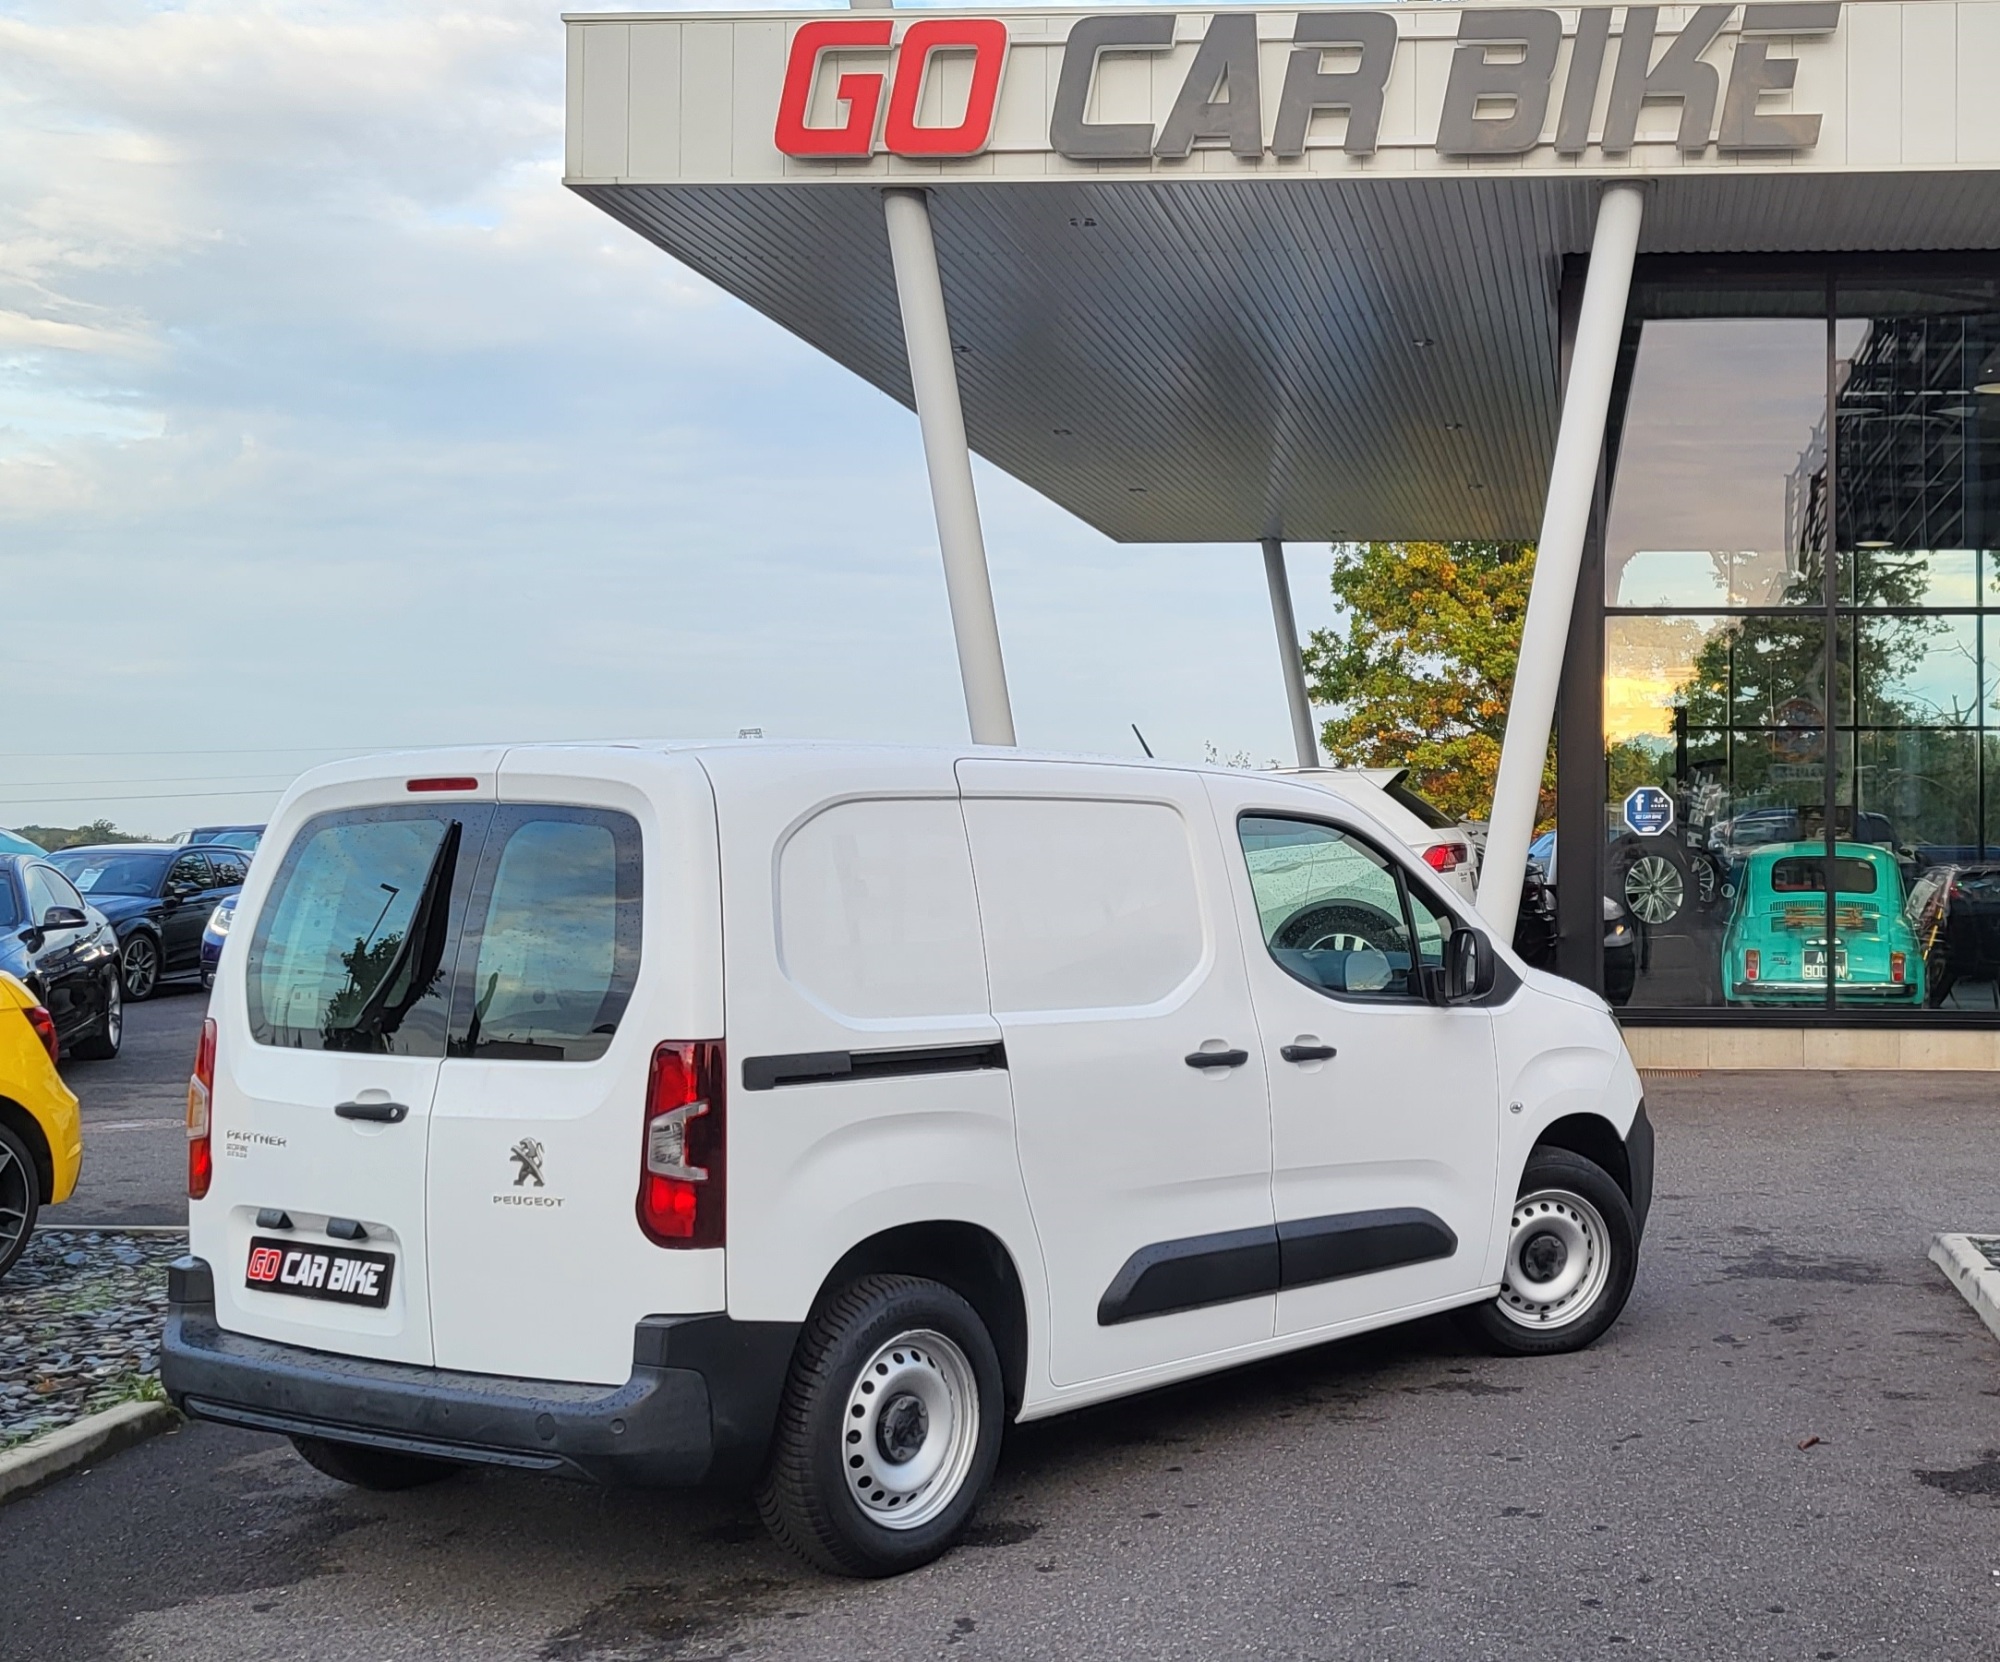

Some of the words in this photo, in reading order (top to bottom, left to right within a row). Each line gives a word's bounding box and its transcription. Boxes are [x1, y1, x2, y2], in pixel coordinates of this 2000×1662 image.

[774, 19, 1009, 160] GO
[1050, 11, 1402, 163] CAR
[1433, 3, 1842, 161] BIKE
[226, 1129, 288, 1147] PARTNER
[493, 1195, 565, 1207] PEUGEOT
[248, 1248, 282, 1281] GO
[280, 1252, 329, 1288] CAR
[327, 1258, 385, 1296] BIKE
